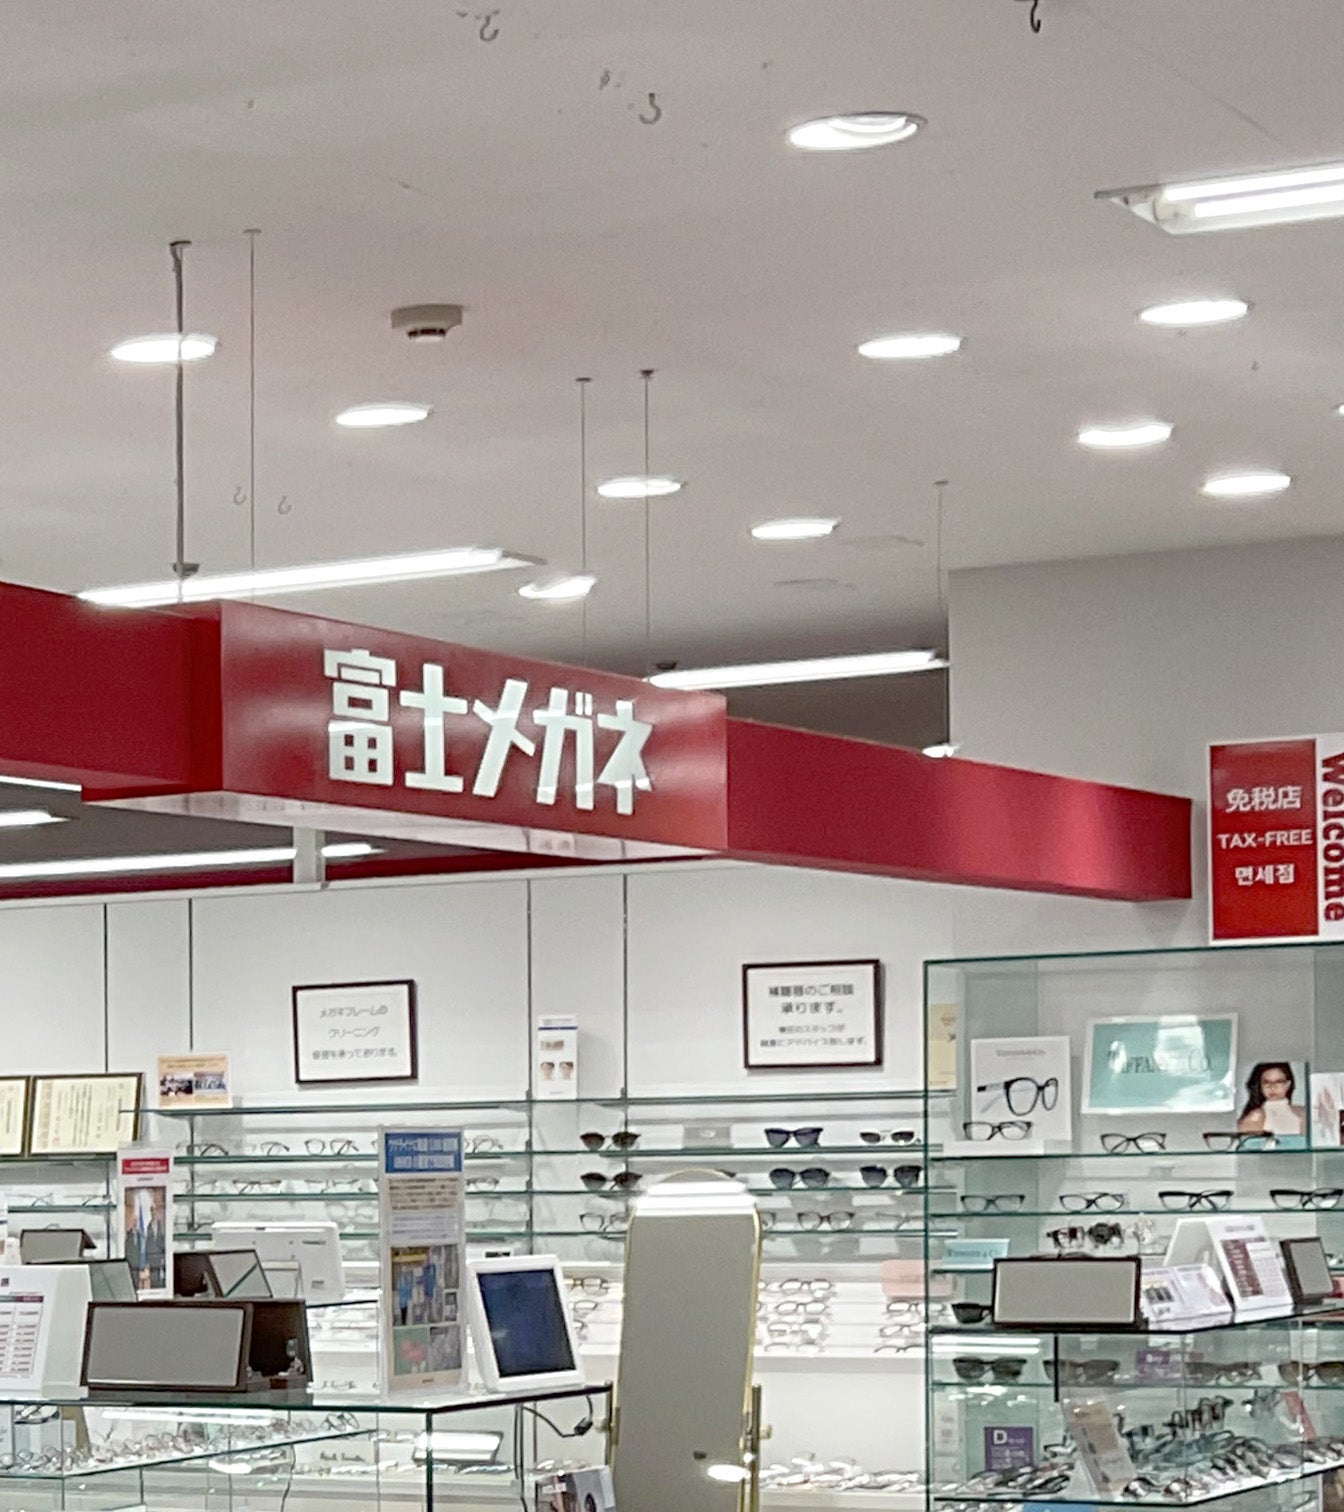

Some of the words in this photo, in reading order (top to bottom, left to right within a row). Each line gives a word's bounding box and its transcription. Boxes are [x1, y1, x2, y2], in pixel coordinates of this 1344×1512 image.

[324, 649, 654, 815] 富士メガネ
[1226, 786, 1301, 813] 免税店
[1217, 829, 1312, 849] TAX-FREE
[1235, 863, 1295, 886] 면세점
